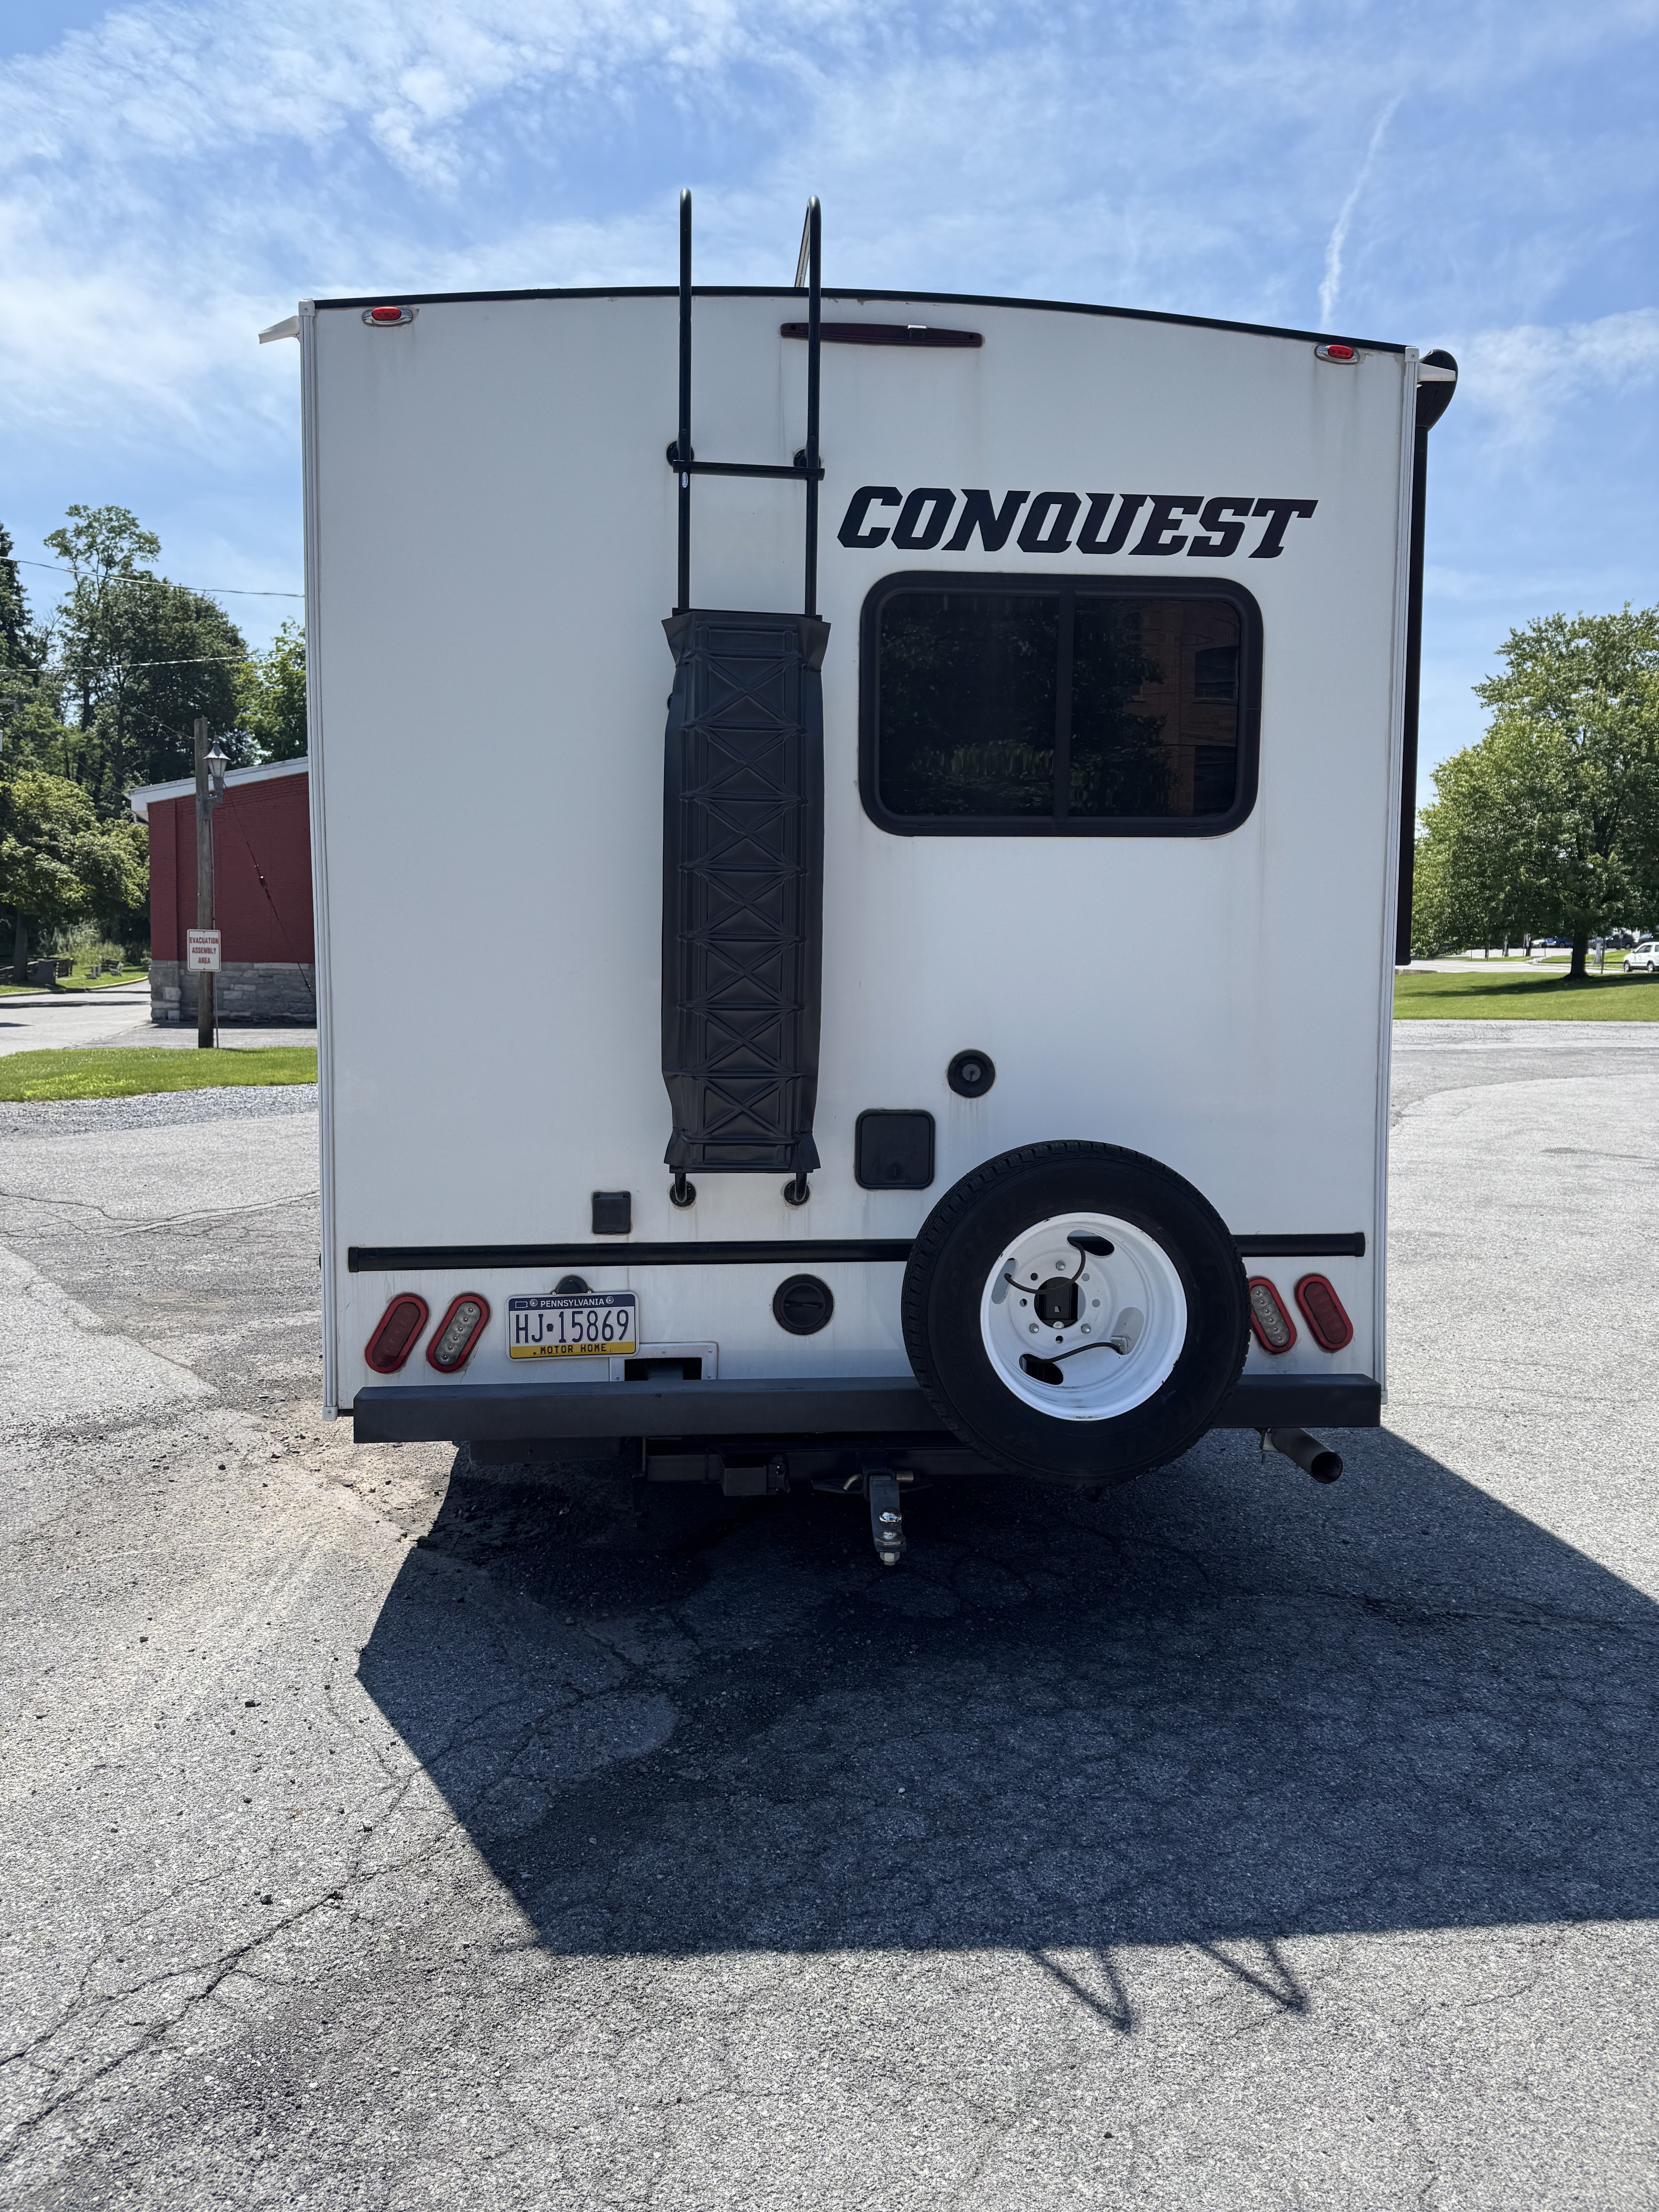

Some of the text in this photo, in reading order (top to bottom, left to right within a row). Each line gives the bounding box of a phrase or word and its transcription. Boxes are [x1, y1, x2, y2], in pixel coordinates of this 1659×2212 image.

[836, 486, 1319, 558] CONQUEST
[541, 1298, 604, 1307] PENNSYLVANIA
[540, 1343, 606, 1354] MOTOR HOME
